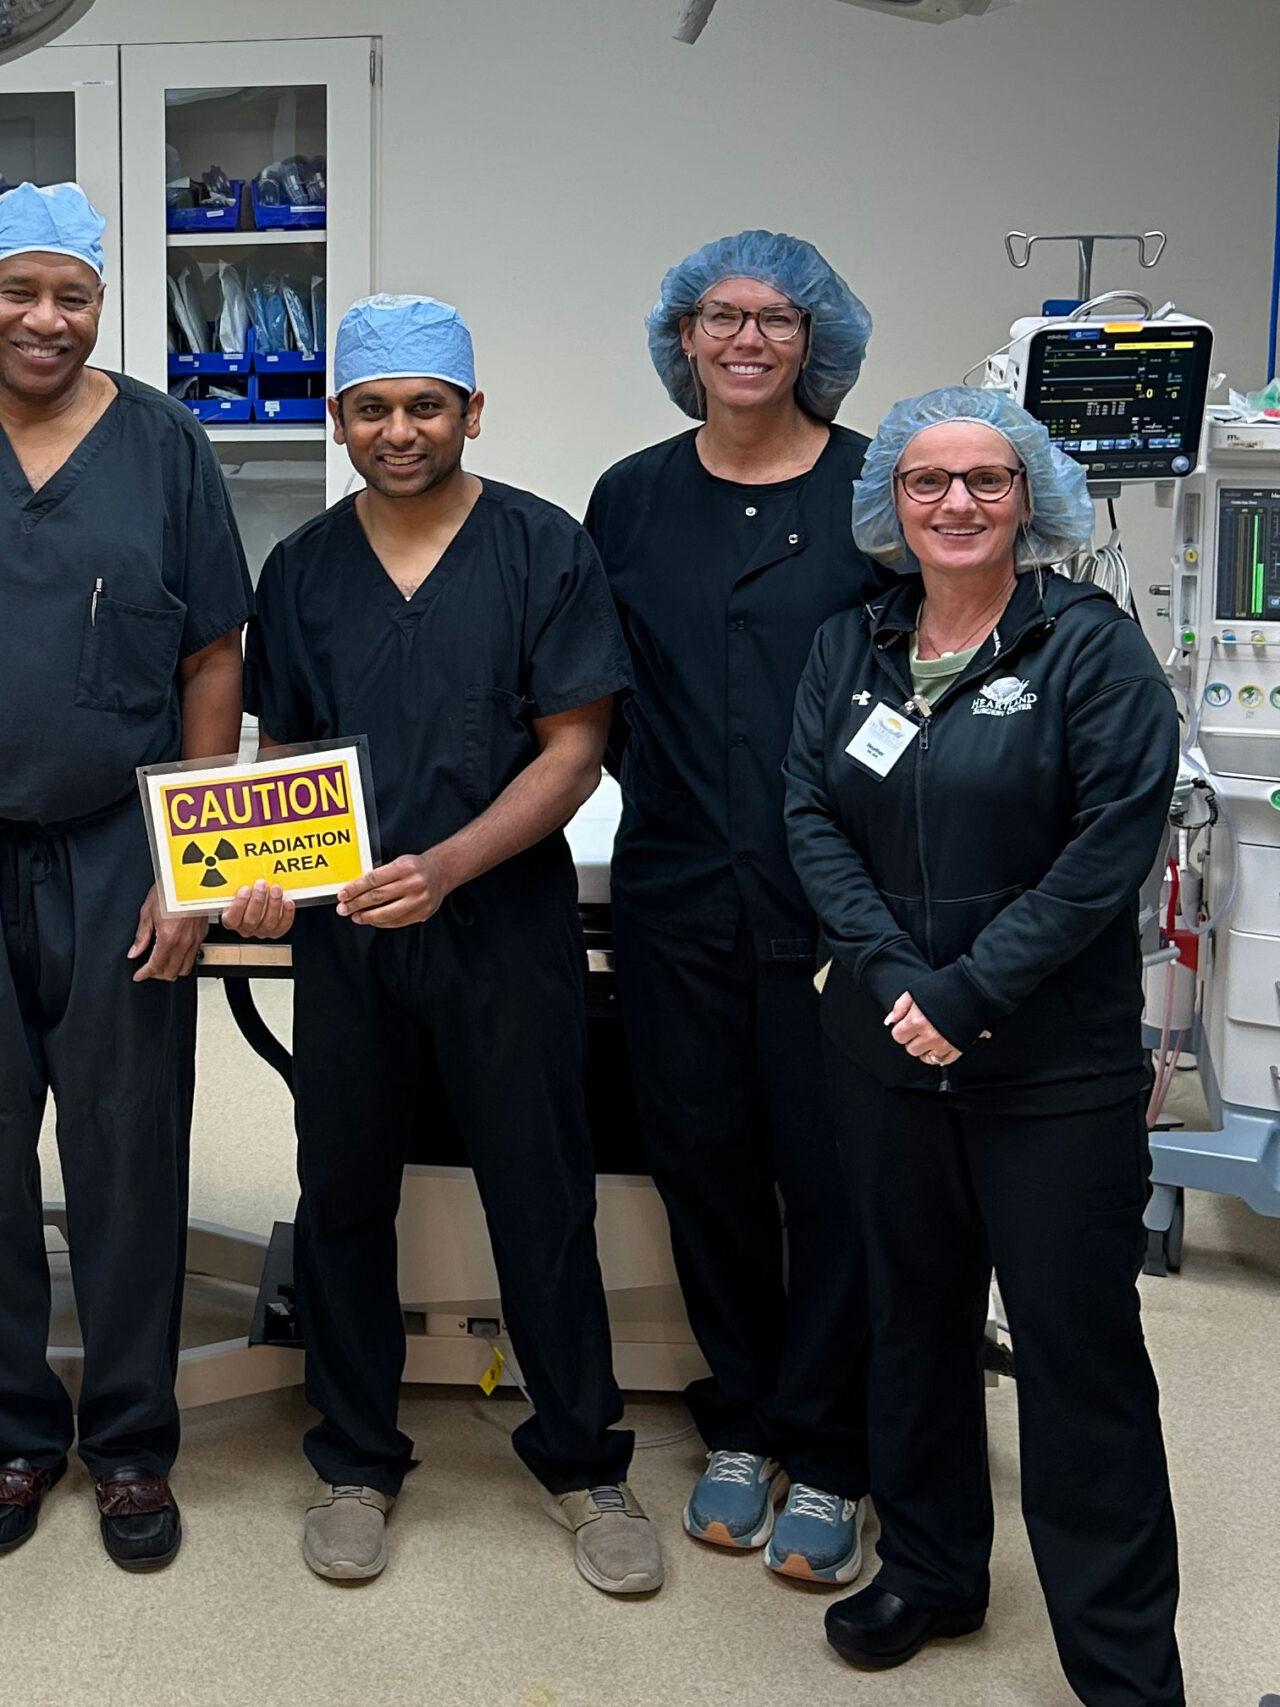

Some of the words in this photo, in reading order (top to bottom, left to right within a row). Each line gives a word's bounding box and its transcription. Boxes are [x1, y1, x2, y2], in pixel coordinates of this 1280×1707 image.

[970, 692, 1038, 711] HEARTLAND
[170, 771, 346, 830] CAUTION
[244, 829, 351, 857] RADIATION
[273, 854, 329, 874] AREA
